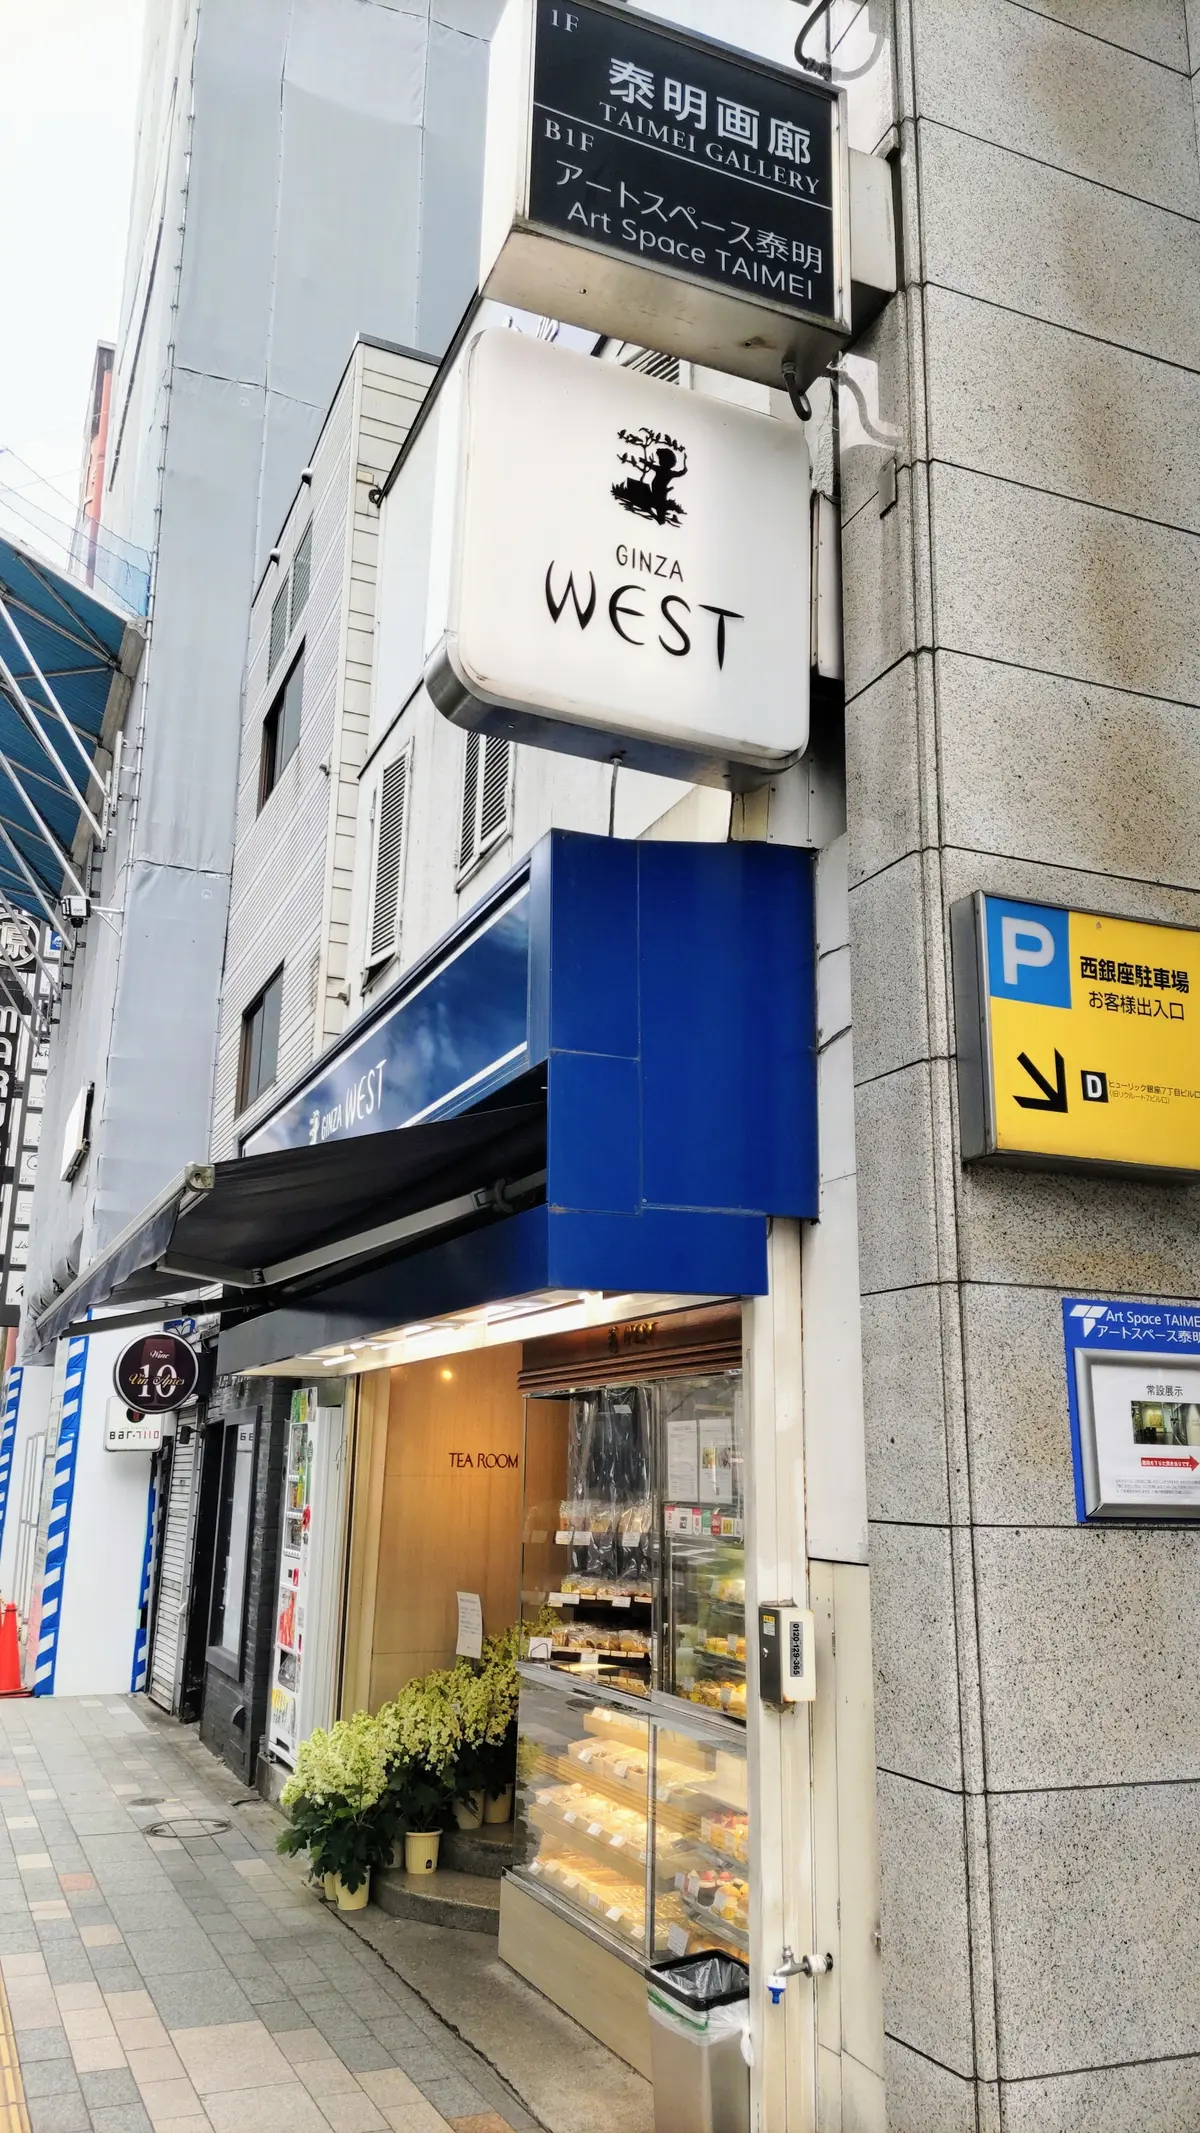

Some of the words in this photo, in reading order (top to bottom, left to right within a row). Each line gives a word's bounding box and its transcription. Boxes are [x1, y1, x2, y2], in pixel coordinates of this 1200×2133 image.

[551, 9, 580, 33] 1F
[609, 58, 811, 165] 泰明画廊
[544, 119, 596, 153] B1F
[599, 101, 697, 154] TAIMEI
[705, 142, 820, 195] GALLERY
[556, 160, 823, 274] アートスペース泰明
[567, 202, 612, 235] Art
[621, 219, 707, 264] Space
[716, 249, 813, 300] TAIMEI
[616, 544, 684, 583] GINZA
[545, 560, 745, 672] WEST
[1001, 916, 1055, 985] P
[1080, 955, 1189, 994] 西銀座駐車場
[1089, 990, 1185, 1021] お客様出入口
[321, 1103, 342, 1141] GINZA
[345, 1059, 387, 1130] WEST
[1086, 1074, 1103, 1098] D
[1106, 1310, 1125, 1323] Art
[1127, 1311, 1161, 1326] Space
[149, 1350, 170, 1359] Wine
[138, 1364, 178, 1398] 10
[1146, 1384, 1184, 1398] 常設展示
[448, 1452, 474, 1468] TEA
[477, 1453, 519, 1469] ROOM
[793, 1623, 801, 1676] 0120-129-365
